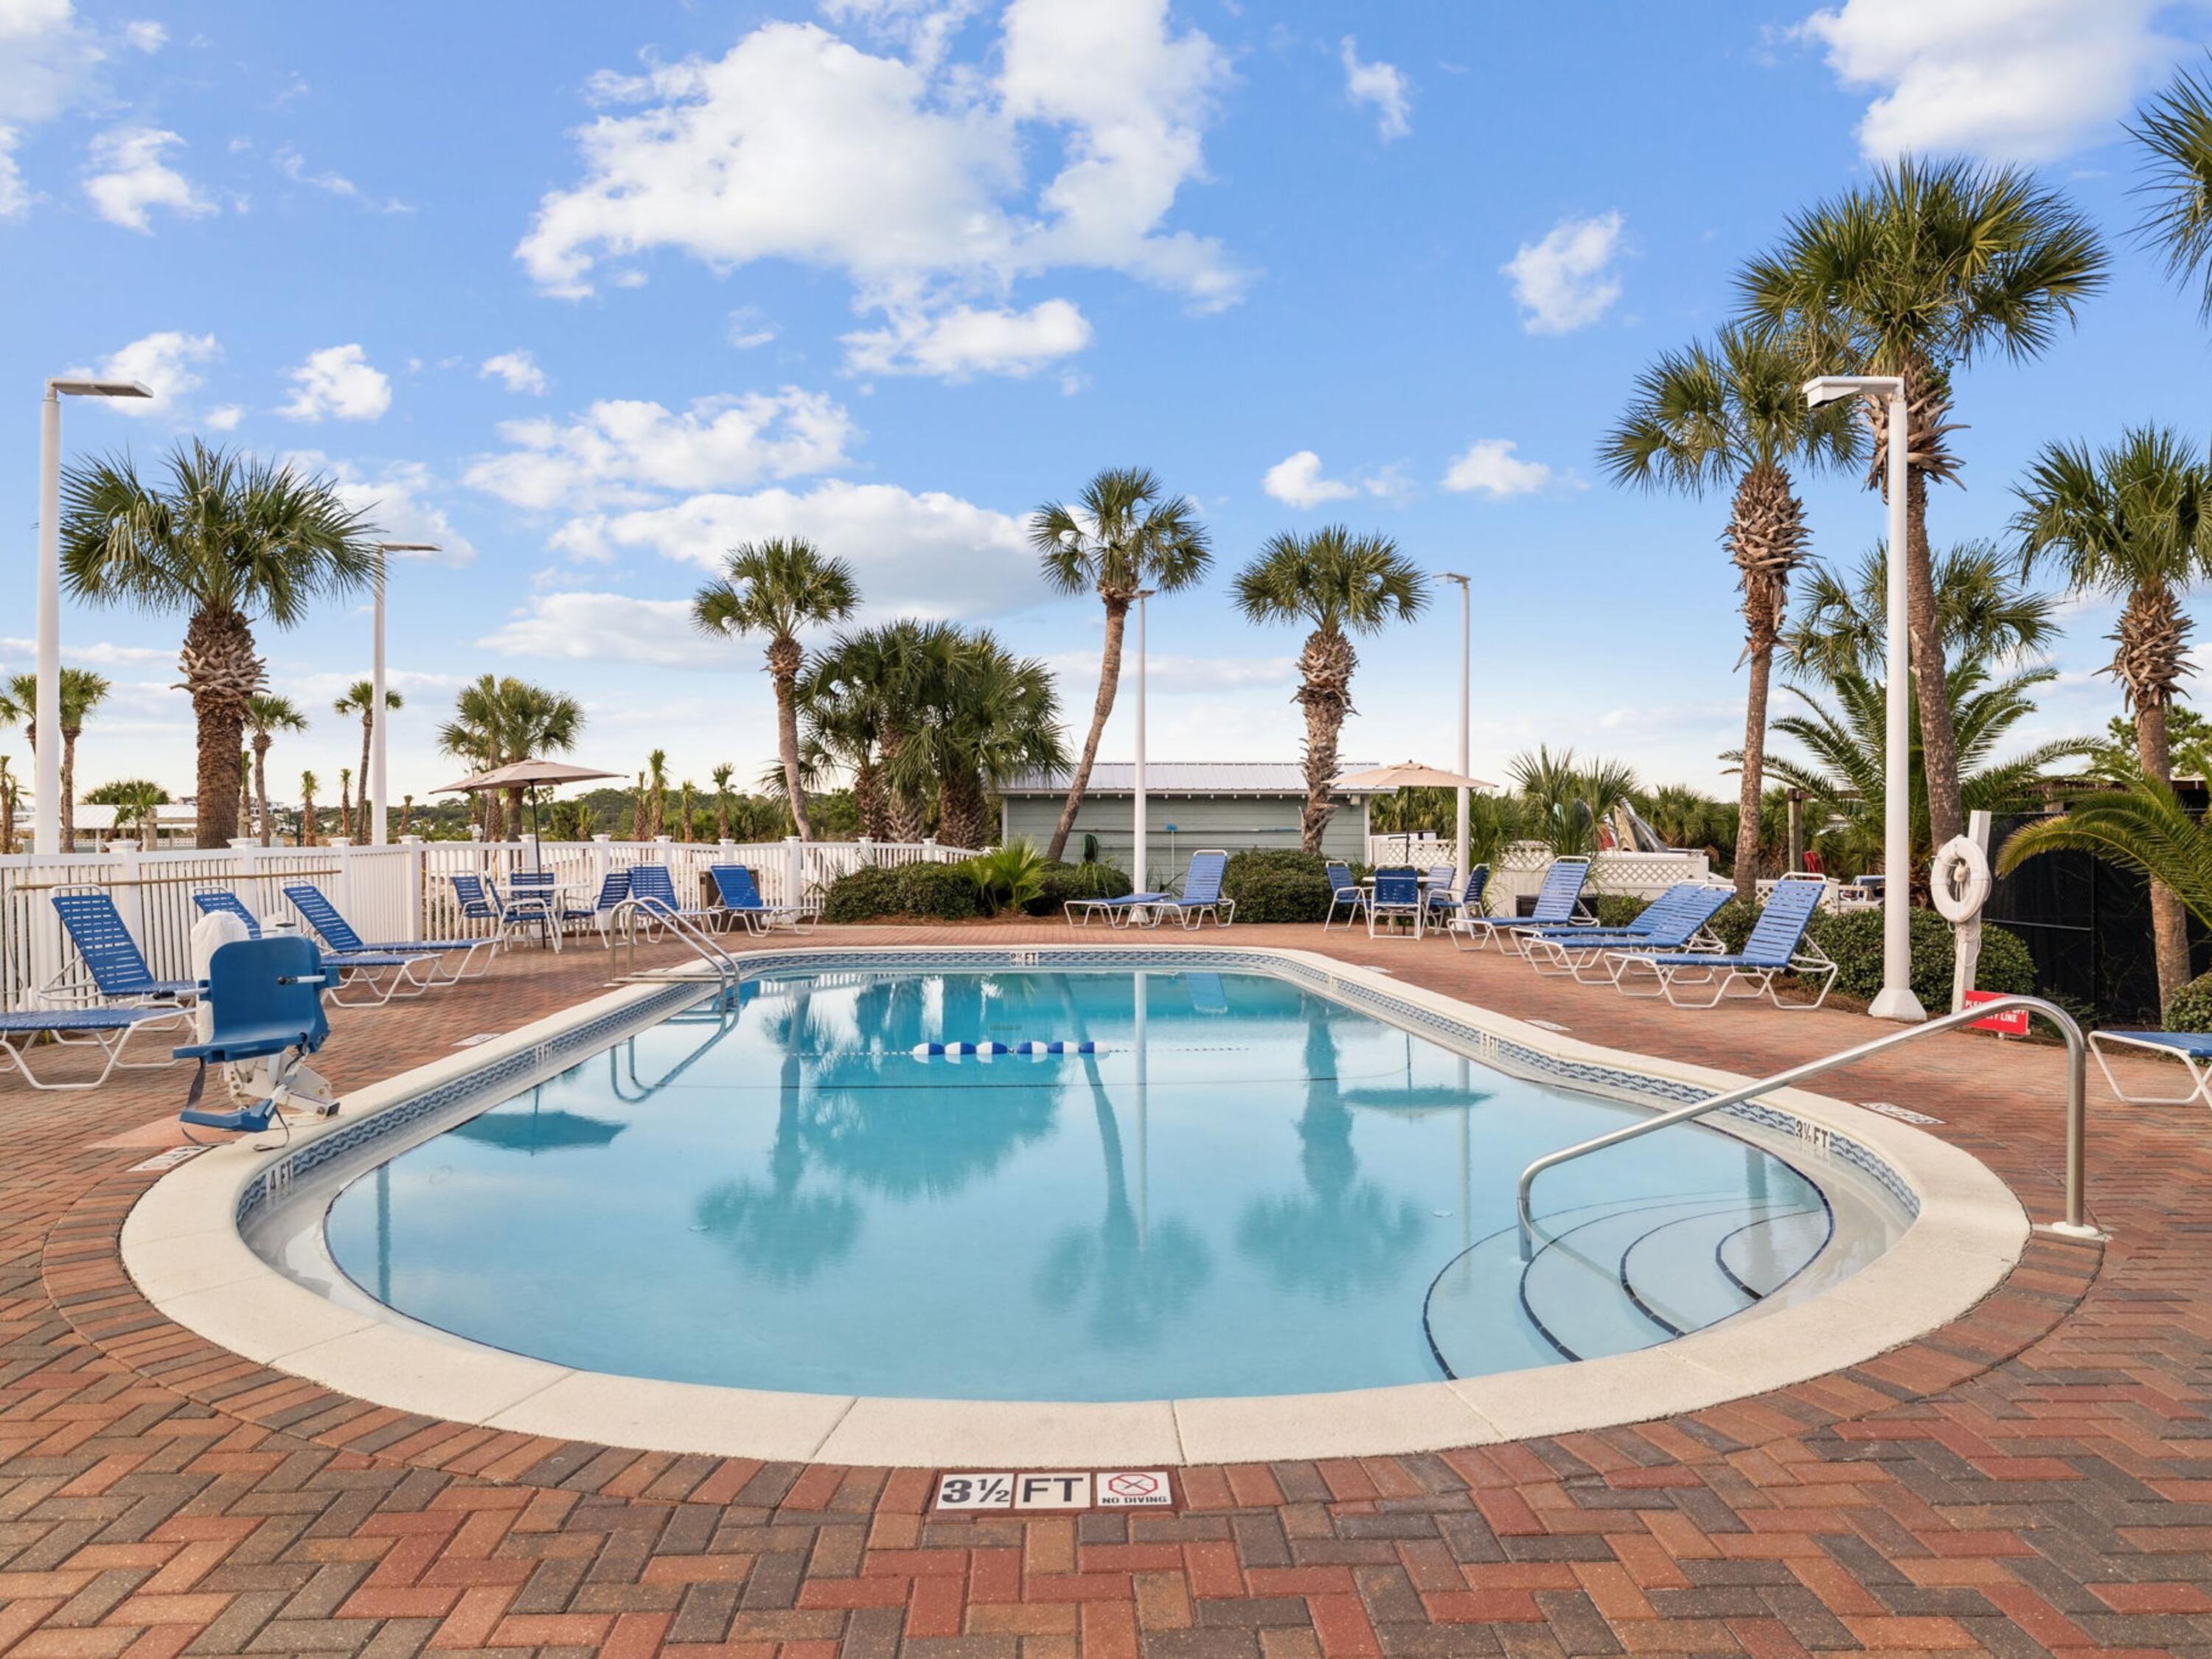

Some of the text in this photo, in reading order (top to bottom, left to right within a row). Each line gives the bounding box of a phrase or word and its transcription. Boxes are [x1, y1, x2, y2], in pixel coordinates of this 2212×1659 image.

[2000, 1012, 2018, 1023] LINE
[1813, 1127, 1828, 1148] FT
[280, 1160, 291, 1184] FT
[941, 1477, 1084, 1503] 3½ FT
[1124, 1496, 1167, 1504] DIVING
